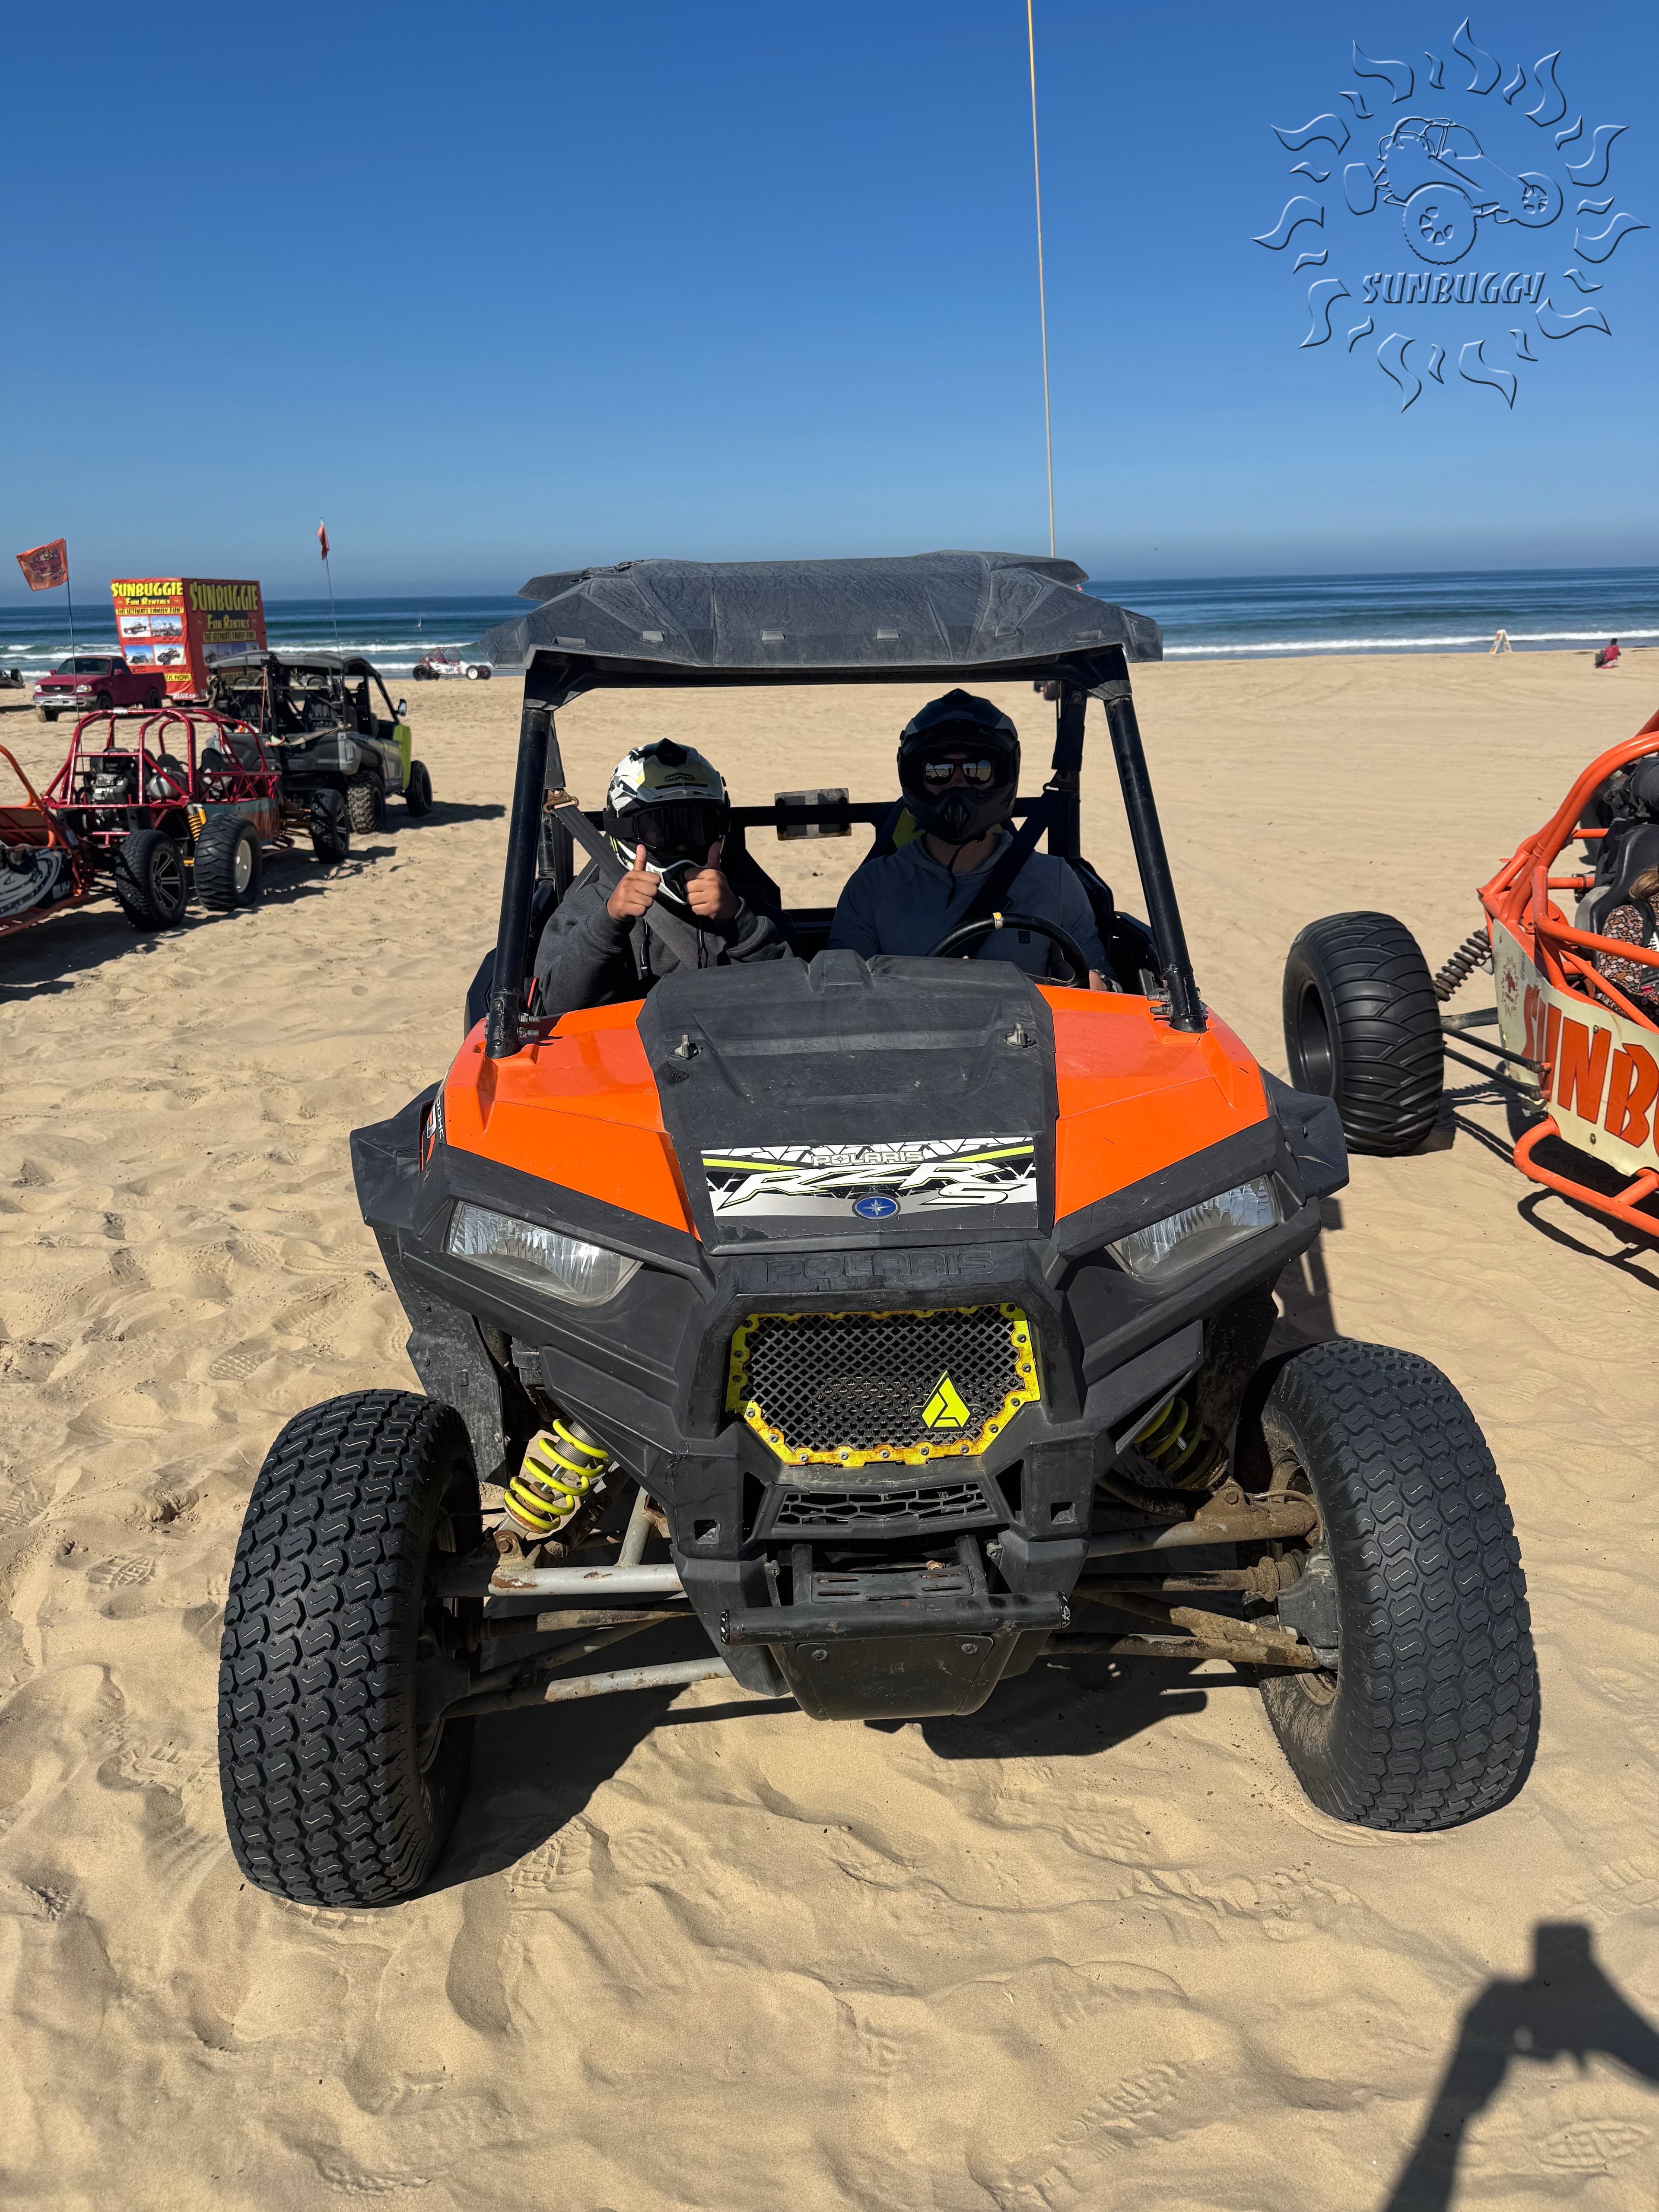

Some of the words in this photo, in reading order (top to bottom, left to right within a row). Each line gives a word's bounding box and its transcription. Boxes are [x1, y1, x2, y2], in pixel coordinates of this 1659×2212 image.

[111, 582, 184, 597] SUNBUGGIE
[190, 581, 258, 611] SUNBUGGIE
[141, 597, 171, 605] RENTALS
[223, 614, 250, 629] RENTALS
[1521, 984, 1659, 1158] SUNB
[811, 1150, 925, 1166] POLARIS
[767, 1251, 995, 1282] POLARIS
